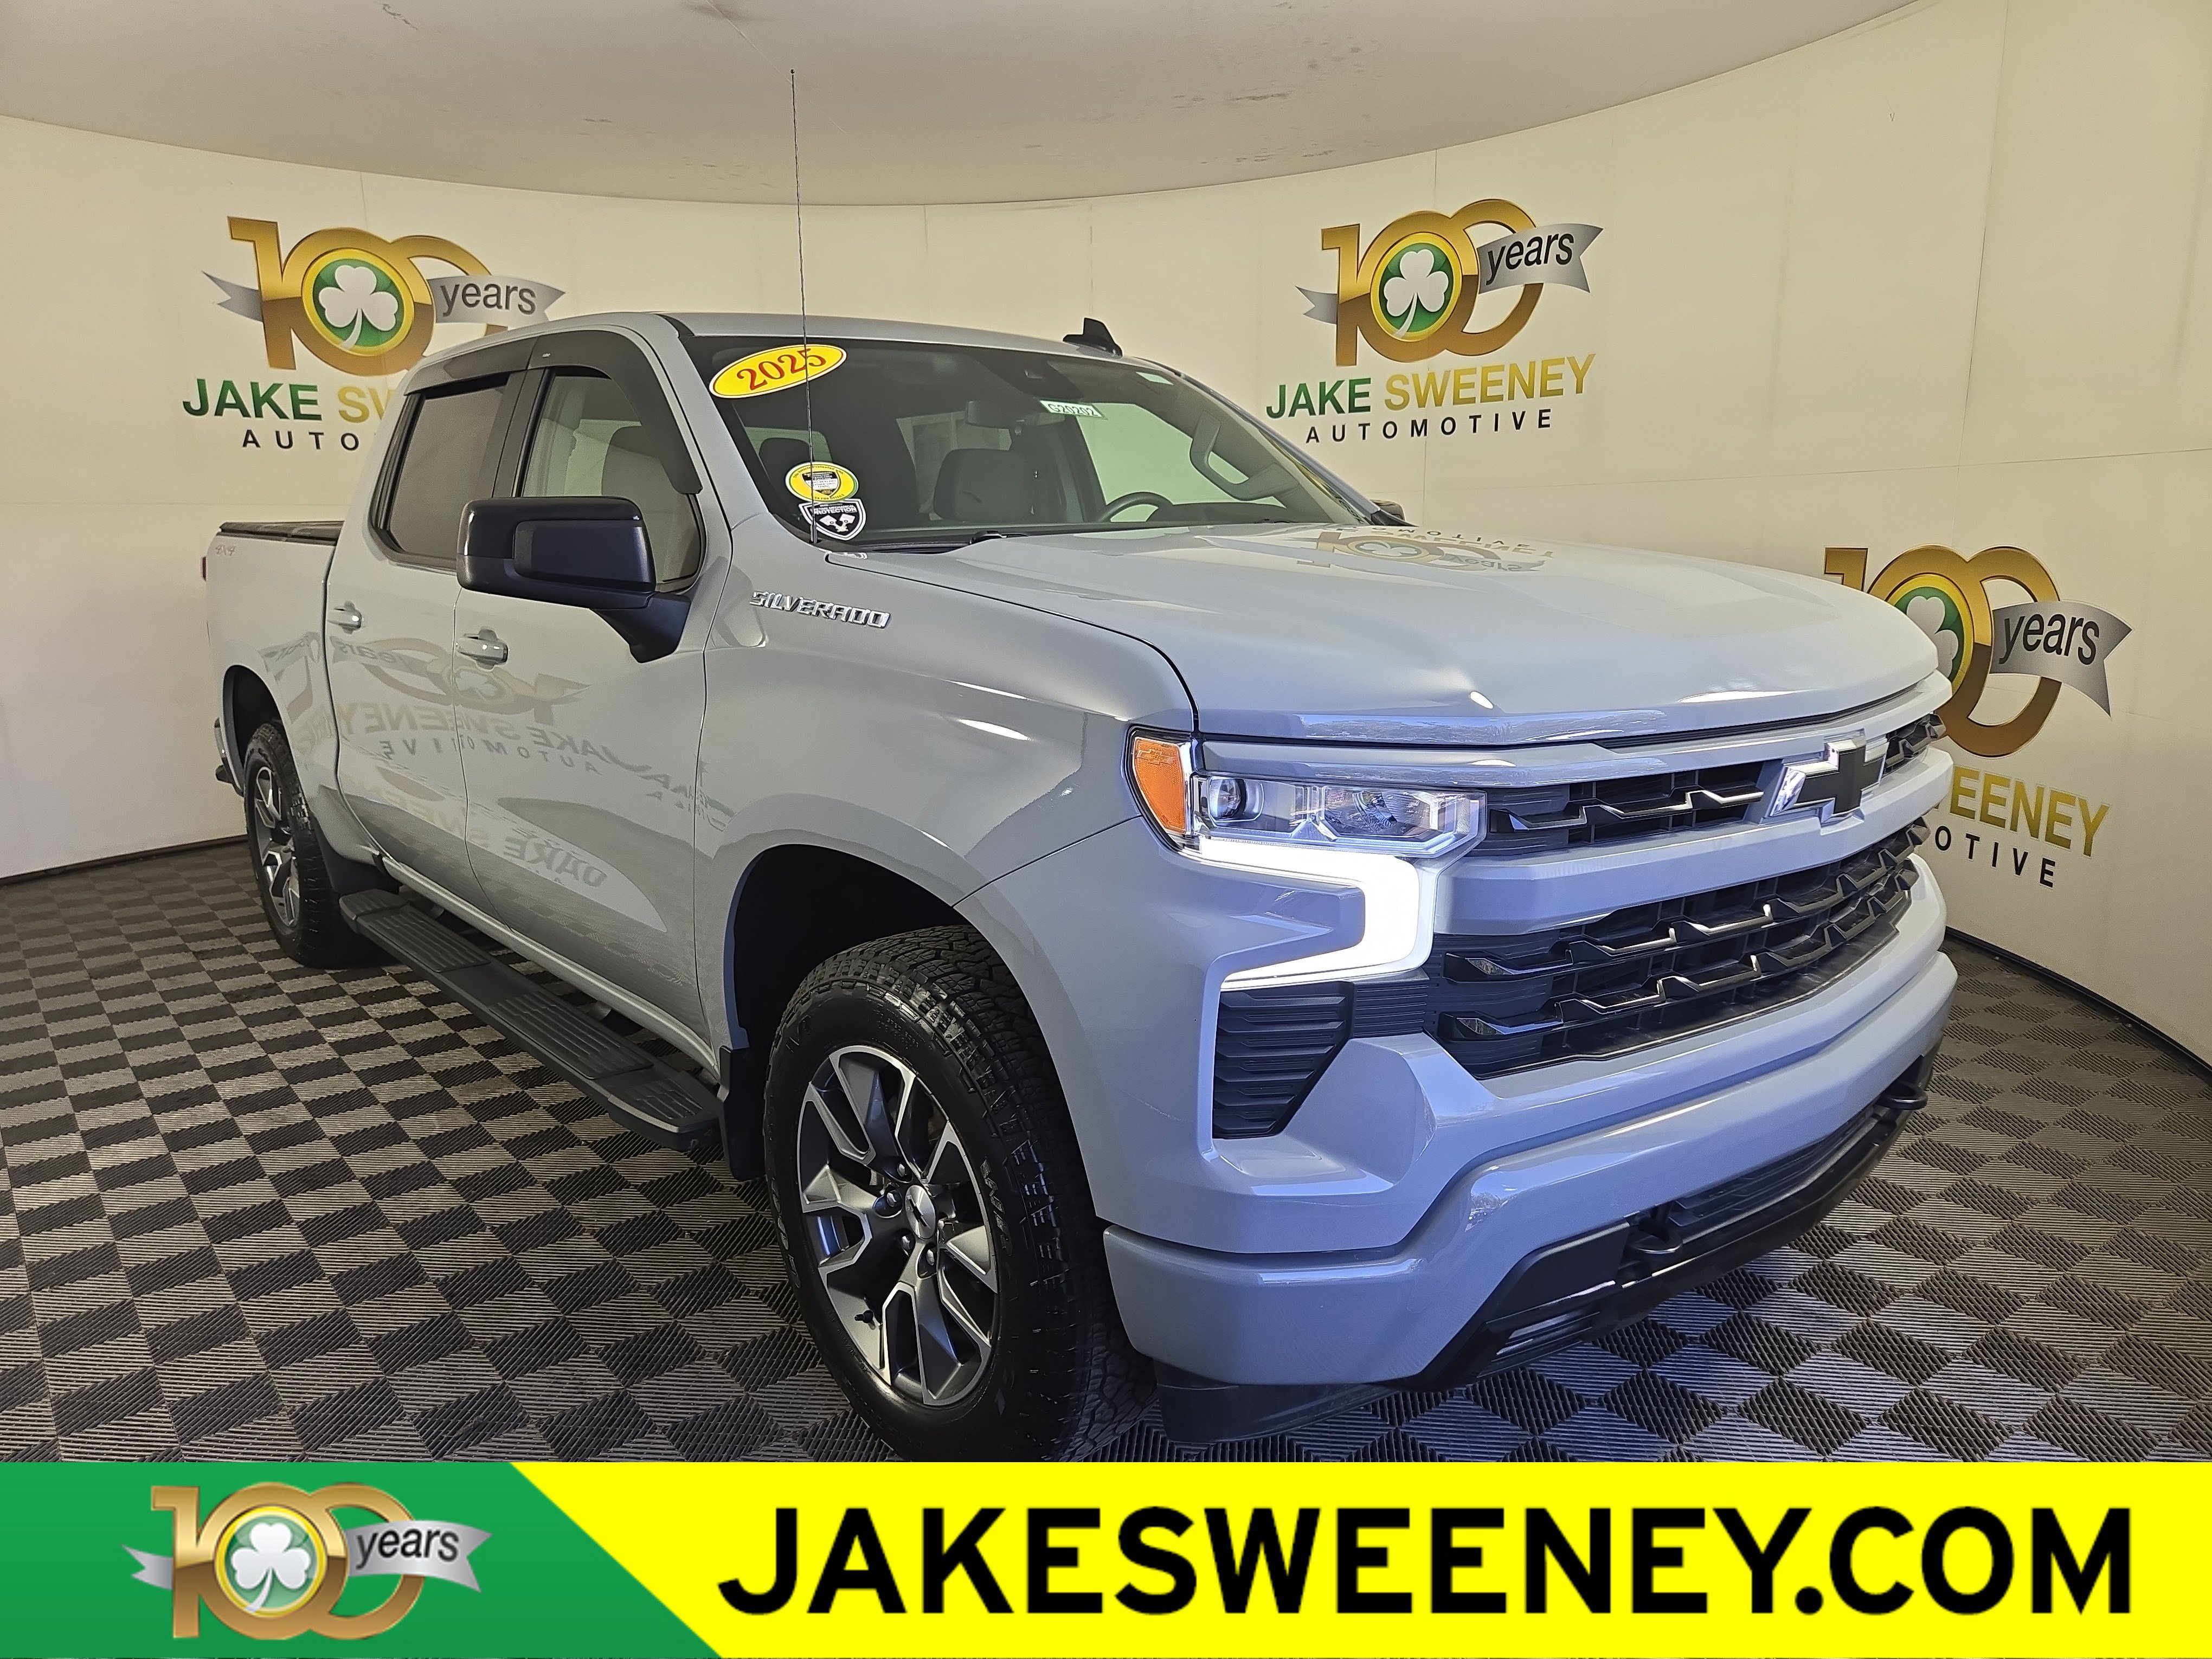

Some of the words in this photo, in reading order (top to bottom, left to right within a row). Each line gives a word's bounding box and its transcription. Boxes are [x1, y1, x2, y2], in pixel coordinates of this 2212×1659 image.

[1486, 233, 1574, 286] years
[440, 281, 536, 316] years
[737, 348, 826, 391] 2025
[1266, 377, 1371, 419] JAKE
[1384, 353, 1596, 411] SWEENEY
[182, 378, 322, 421] JAKE
[1048, 404, 1098, 416] G20202
[242, 429, 359, 451] AUTO
[1306, 409, 1552, 444] AUTOMOTIVE
[750, 591, 892, 629] SILVERADO
[1998, 613, 2099, 665] years
[1949, 766, 2110, 857] EENEY
[1934, 825, 2056, 888] OTIVE
